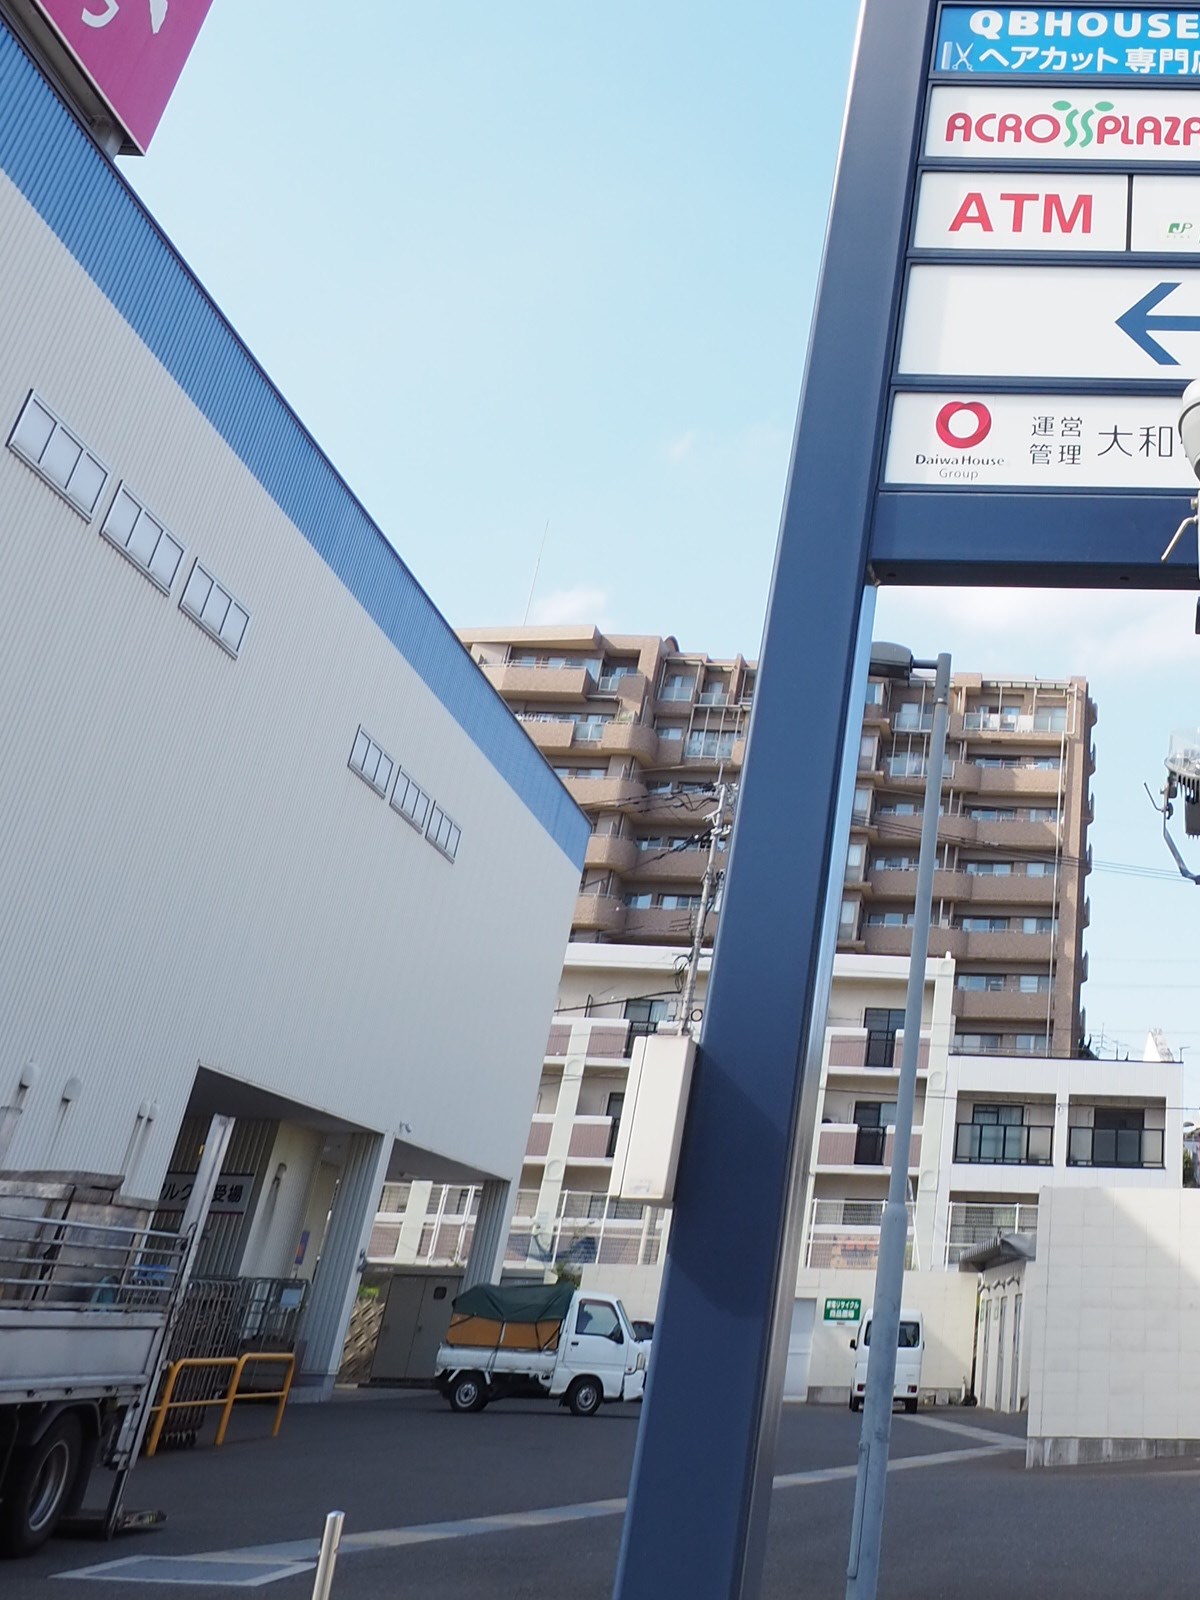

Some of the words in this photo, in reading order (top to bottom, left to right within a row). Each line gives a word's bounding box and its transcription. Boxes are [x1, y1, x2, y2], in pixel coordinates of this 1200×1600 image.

[948, 193, 1092, 233] ATM
[1031, 416, 1083, 437] 運営
[1030, 444, 1081, 465] 管理
[939, 467, 979, 480] Group
